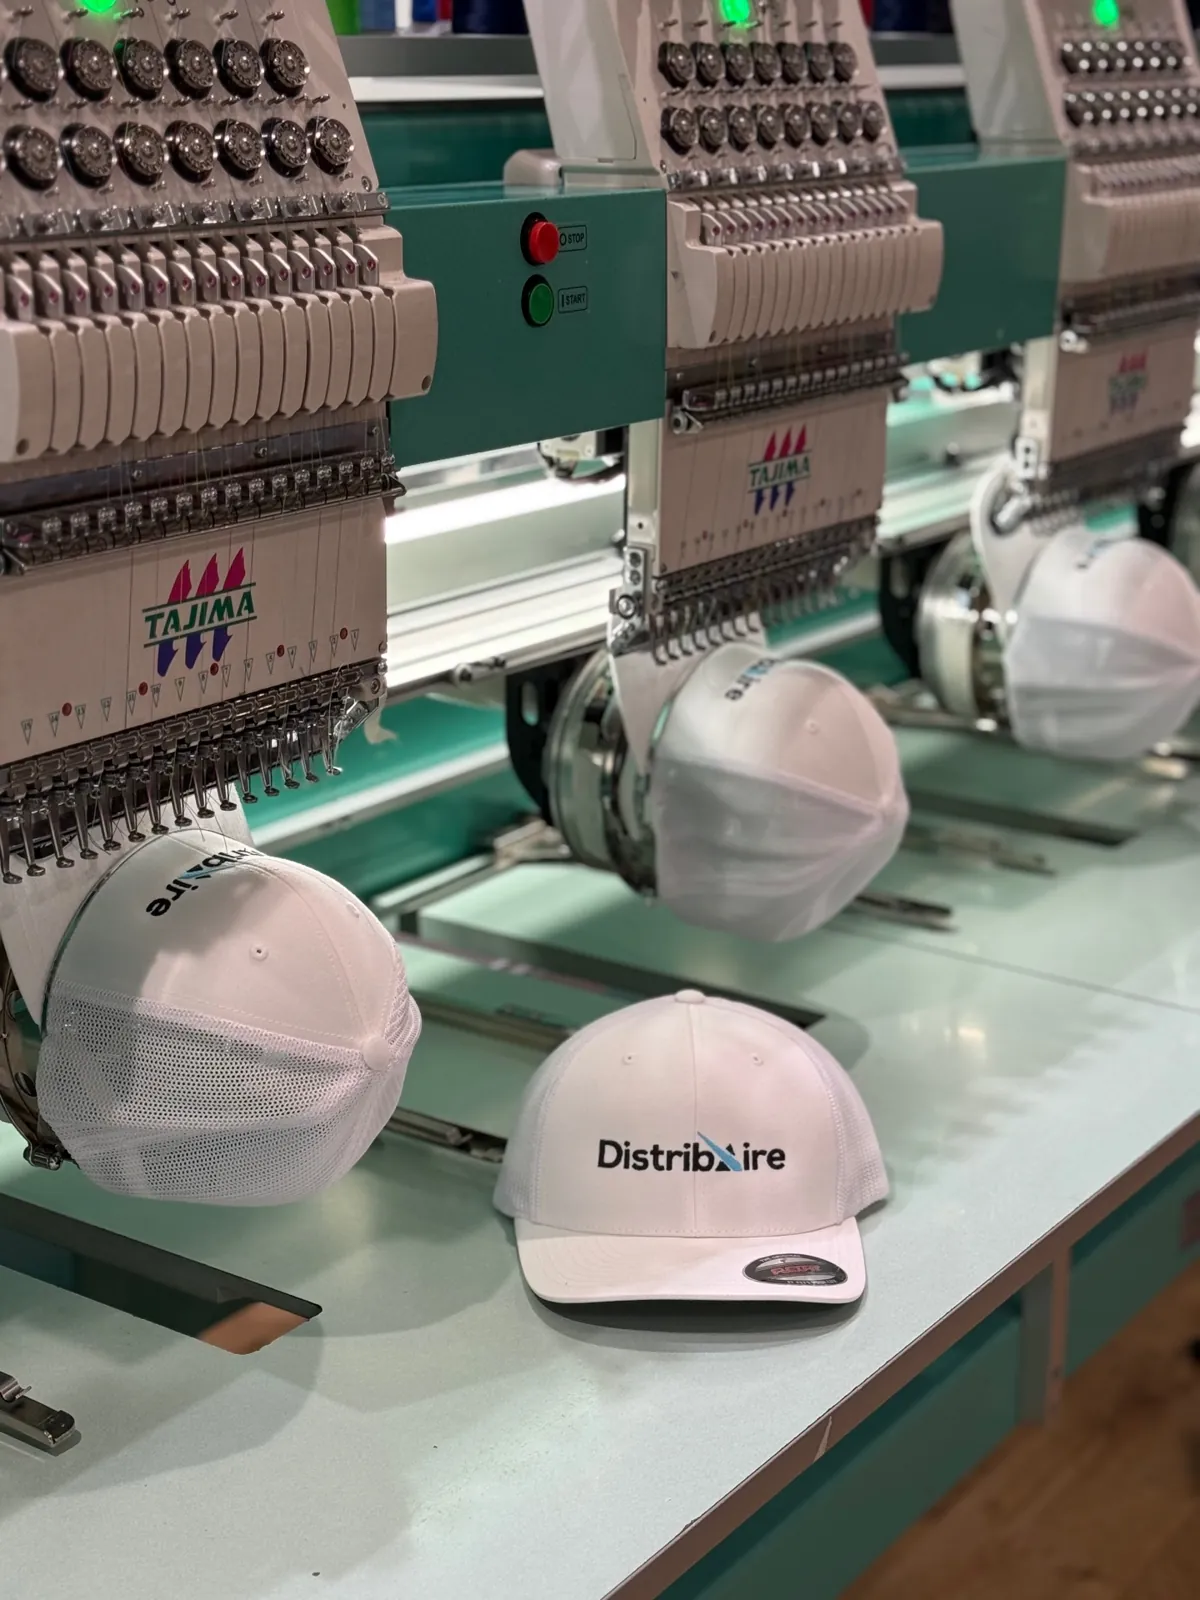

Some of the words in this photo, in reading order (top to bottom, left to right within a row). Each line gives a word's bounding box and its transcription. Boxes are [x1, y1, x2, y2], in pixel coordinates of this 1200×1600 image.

[567, 232, 585, 244] STOP
[565, 293, 586, 306] START
[750, 455, 810, 487] TAJIMA
[144, 590, 255, 639] TAJIMA
[598, 1131, 786, 1172] DistribAire
